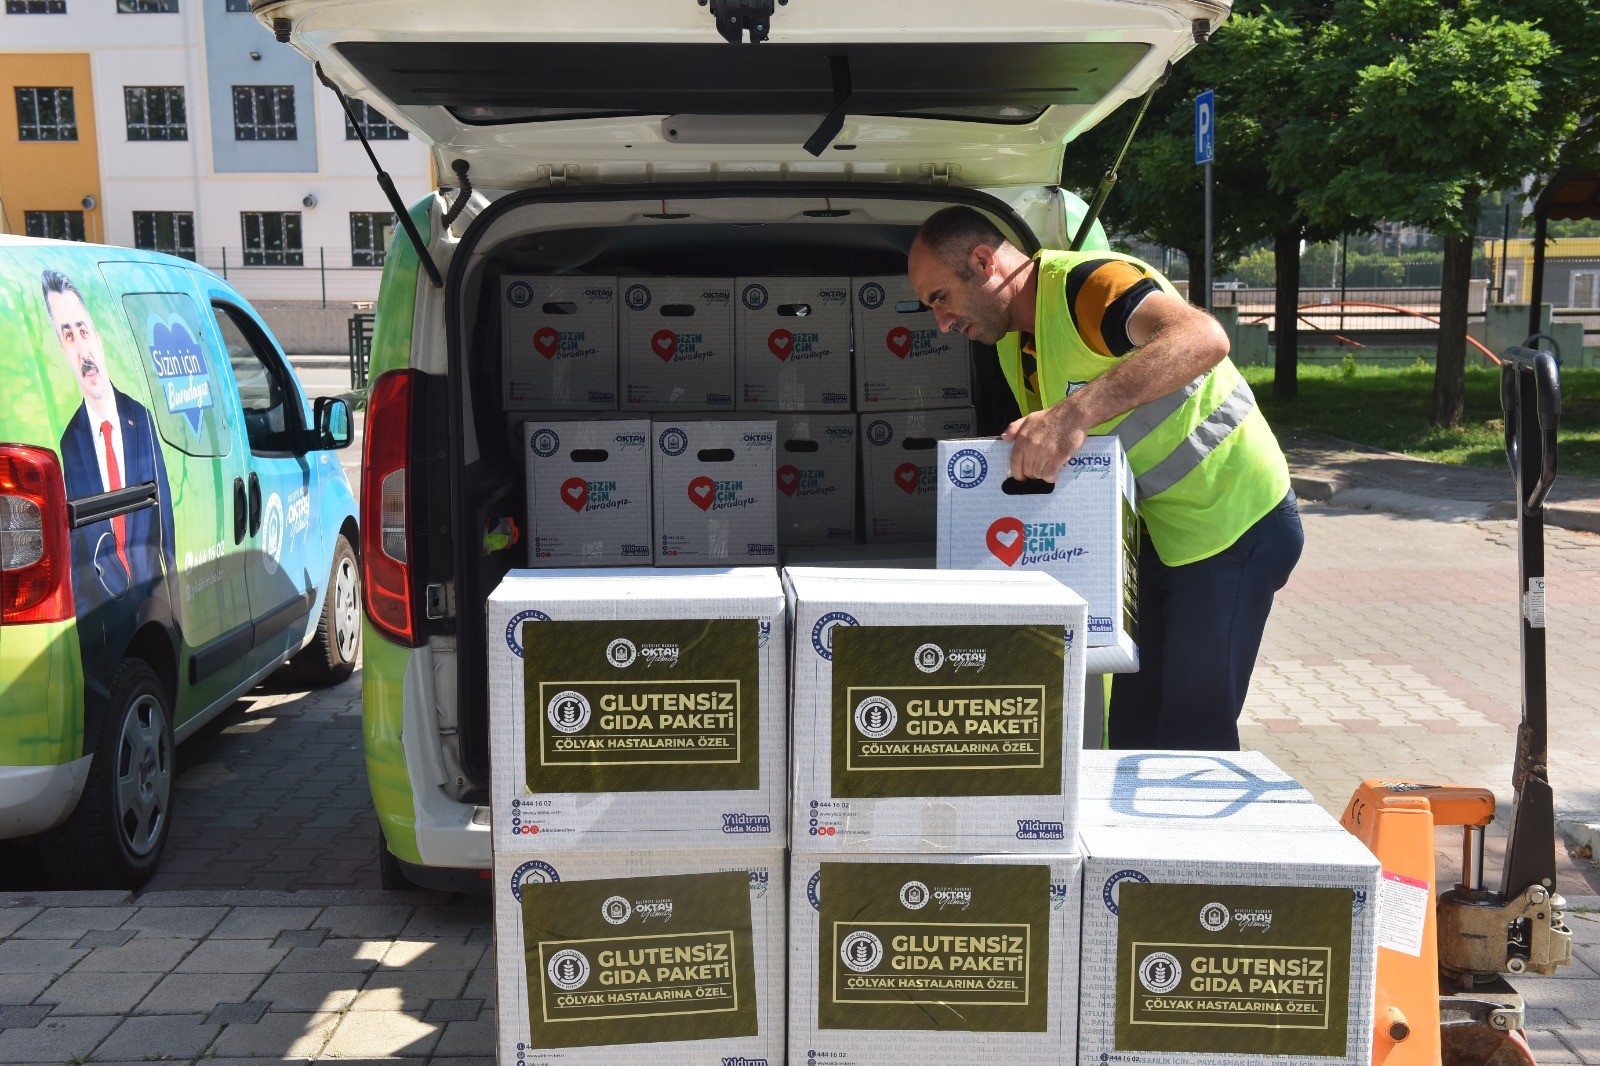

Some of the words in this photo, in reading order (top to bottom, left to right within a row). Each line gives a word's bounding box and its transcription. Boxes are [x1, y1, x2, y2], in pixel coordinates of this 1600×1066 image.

[1199, 103, 1210, 153] P
[152, 350, 182, 377] Sizin
[179, 348, 202, 375] için
[1068, 456, 1111, 466] OKTAY
[216, 540, 225, 558] 02
[1021, 547, 1089, 566] buradayız
[642, 648, 680, 657] OKTAY
[949, 652, 987, 662] OKTAY
[600, 715, 653, 729] GIDA
[907, 721, 959, 735] GIDA
[555, 738, 605, 751] ÇÖLYAK
[608, 739, 694, 747] HASTALARINA
[698, 736, 729, 746] ÖZEL
[861, 743, 911, 756] ÇÖLYAK
[914, 744, 999, 753] HASTALARINA
[1003, 742, 1033, 751] ÖZEL
[723, 814, 769, 824] Yıldırım
[1018, 821, 1063, 830] Yıldırım
[723, 825, 743, 833] Gıda
[1017, 831, 1037, 839] Gıda
[1039, 830, 1063, 839] Kolisi
[934, 891, 972, 900] OKTAY
[636, 902, 673, 912] OKTAY
[1234, 913, 1273, 922] OKTAY
[892, 956, 943, 970] GIDA
[599, 969, 651, 985] GIDA
[847, 977, 896, 990] ÇÖLYAK
[898, 979, 984, 990] HASTALARINA
[986, 979, 1018, 991] ÖZEL
[1191, 977, 1243, 992] GIDA
[556, 995, 604, 1008] ÇÖLYAK
[608, 990, 692, 1004] HASTALARINA
[696, 987, 727, 999] ÖZEL
[1144, 998, 1194, 1012] ÇÖLYAK
[1196, 1001, 1283, 1013] HASTALARINA
[1286, 1001, 1318, 1014] ÖZEL
